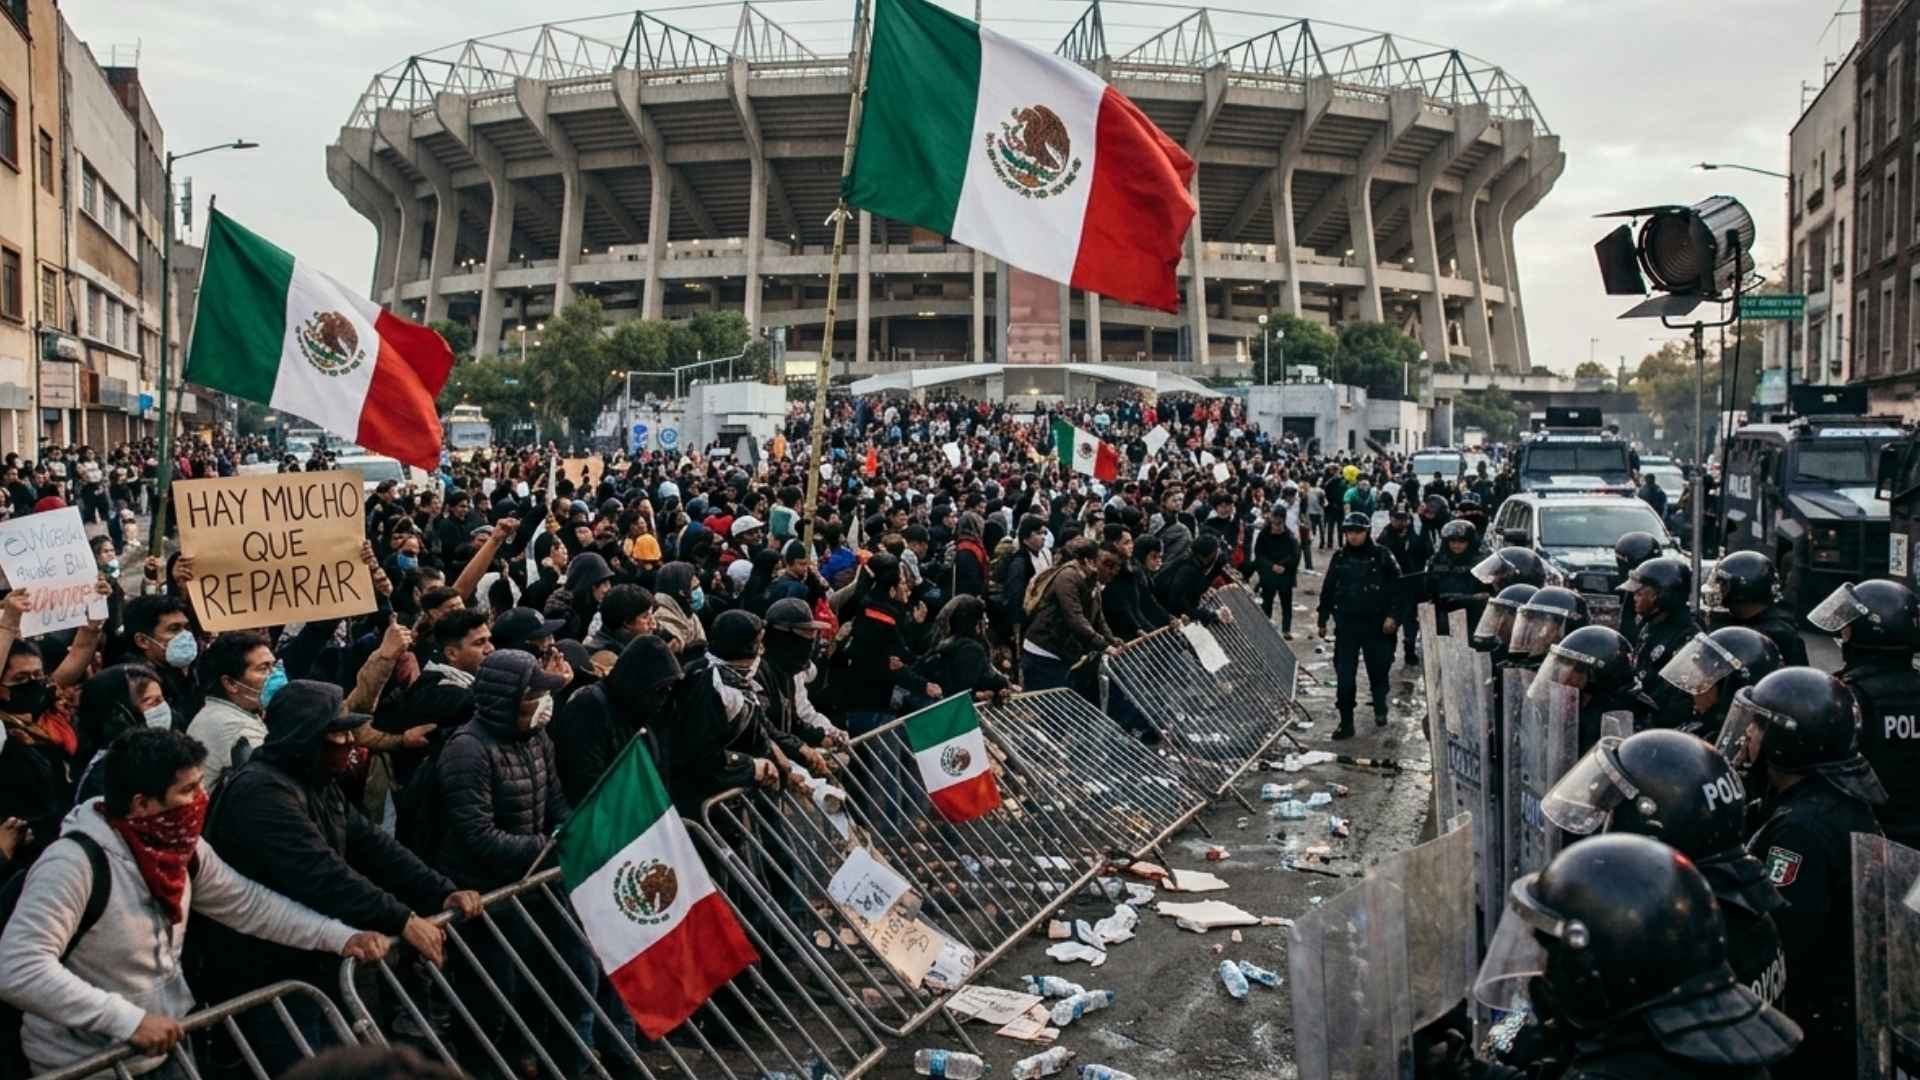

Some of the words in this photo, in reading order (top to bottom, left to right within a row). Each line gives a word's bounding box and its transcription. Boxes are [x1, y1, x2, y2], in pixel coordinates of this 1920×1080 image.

[187, 489, 248, 528] HAY
[263, 482, 358, 522] MUCHO
[243, 529, 308, 562] QUE
[201, 561, 361, 620] REPARAR
[1885, 715, 1920, 739] POL
